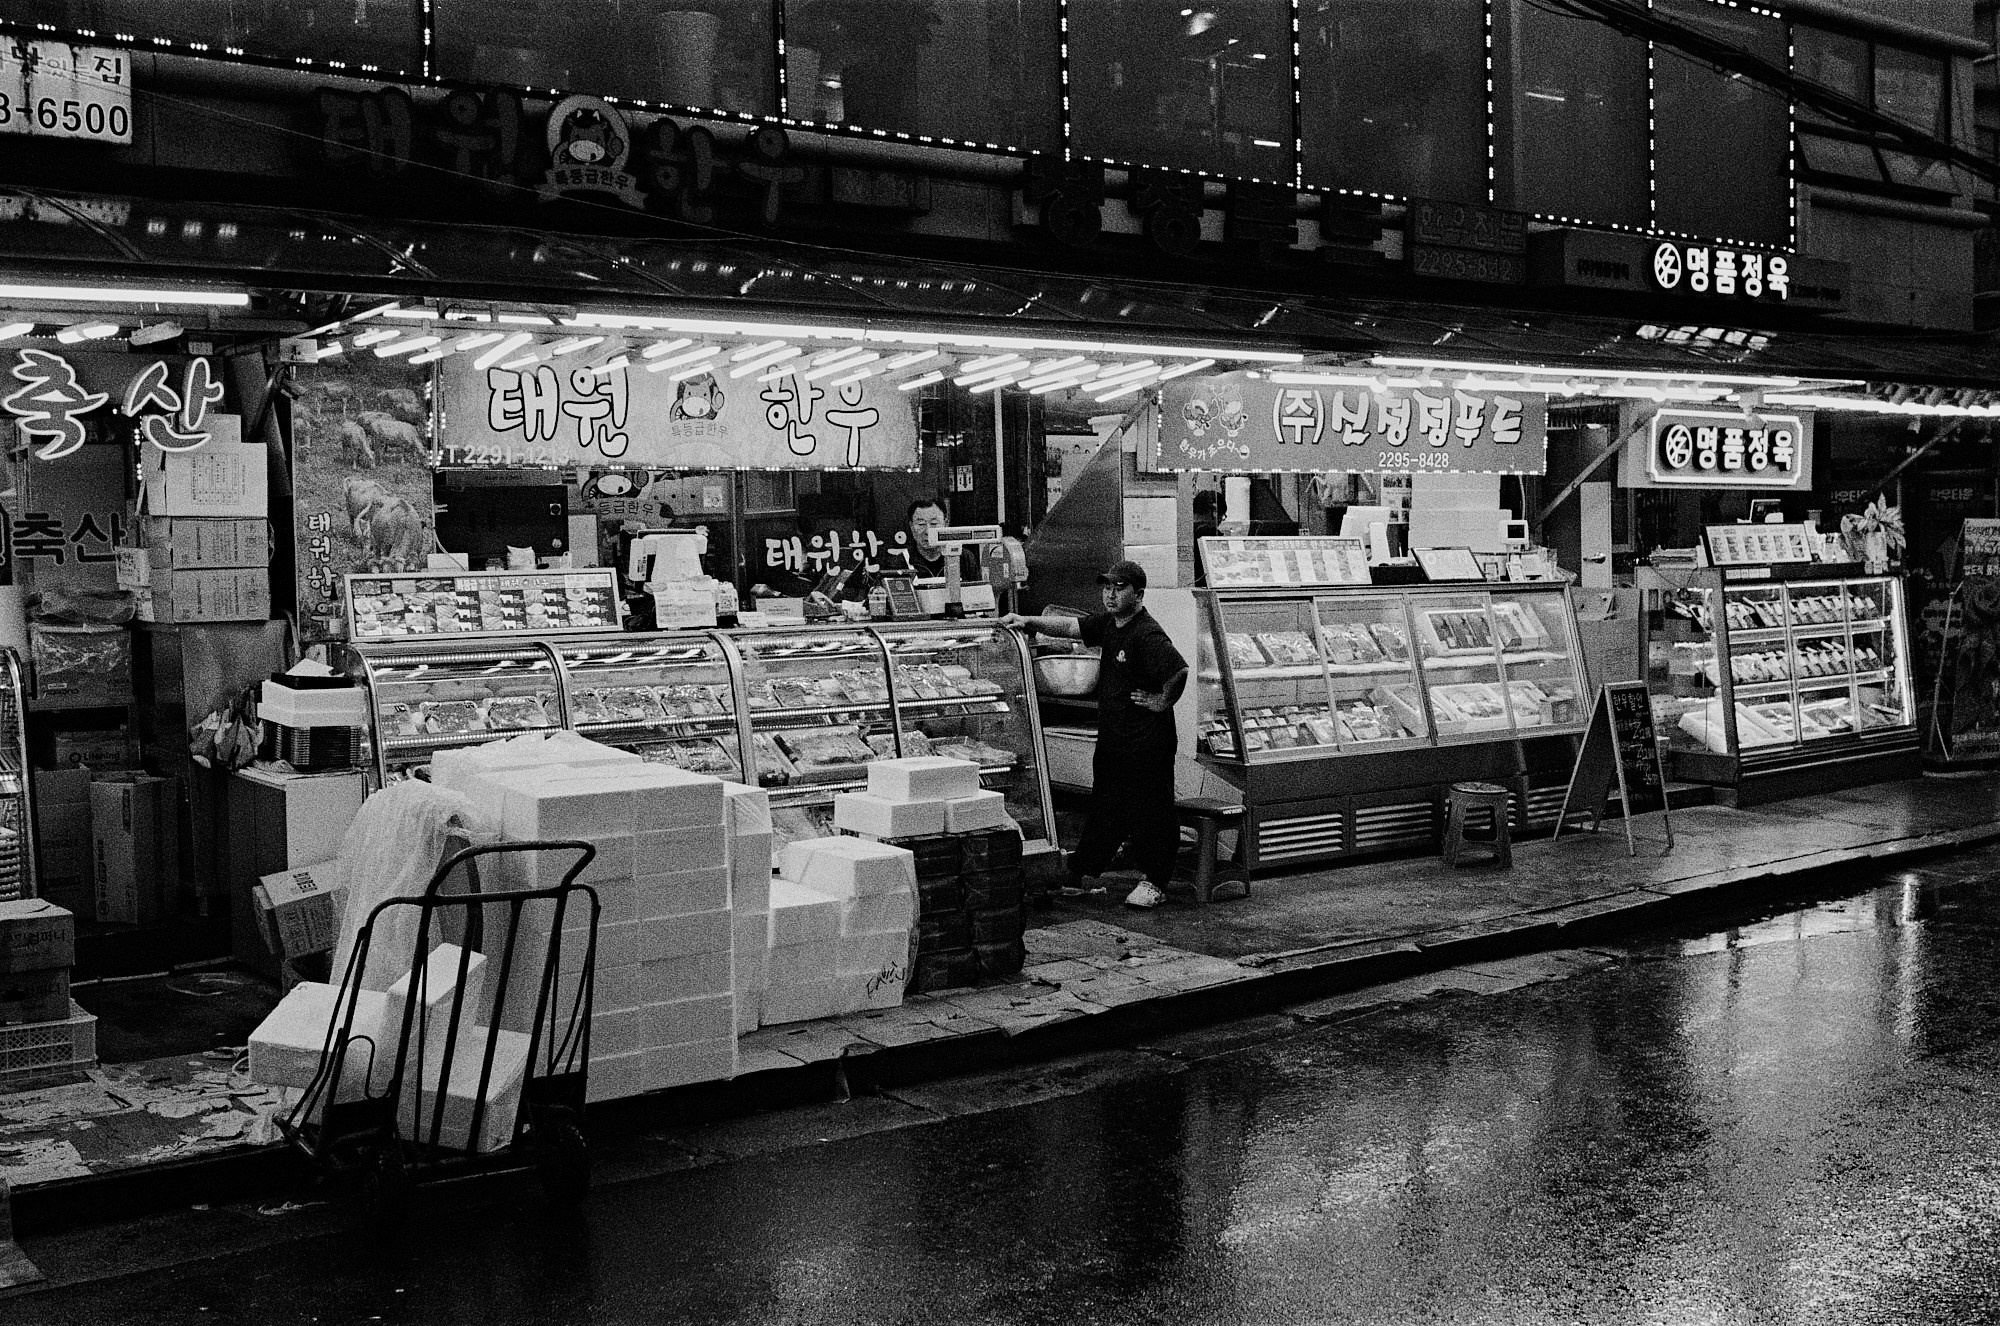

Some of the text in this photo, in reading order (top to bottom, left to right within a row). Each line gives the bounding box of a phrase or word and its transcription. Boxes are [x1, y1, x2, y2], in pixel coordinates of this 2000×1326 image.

[1686, 247, 1790, 300] 명품정육
[1, 348, 225, 461] 축산
[487, 364, 880, 468] 태원 한우
[1378, 451, 1450, 469] 2295-8428
[1696, 426, 1794, 471] 명품정육
[0, 504, 128, 566] 축산
